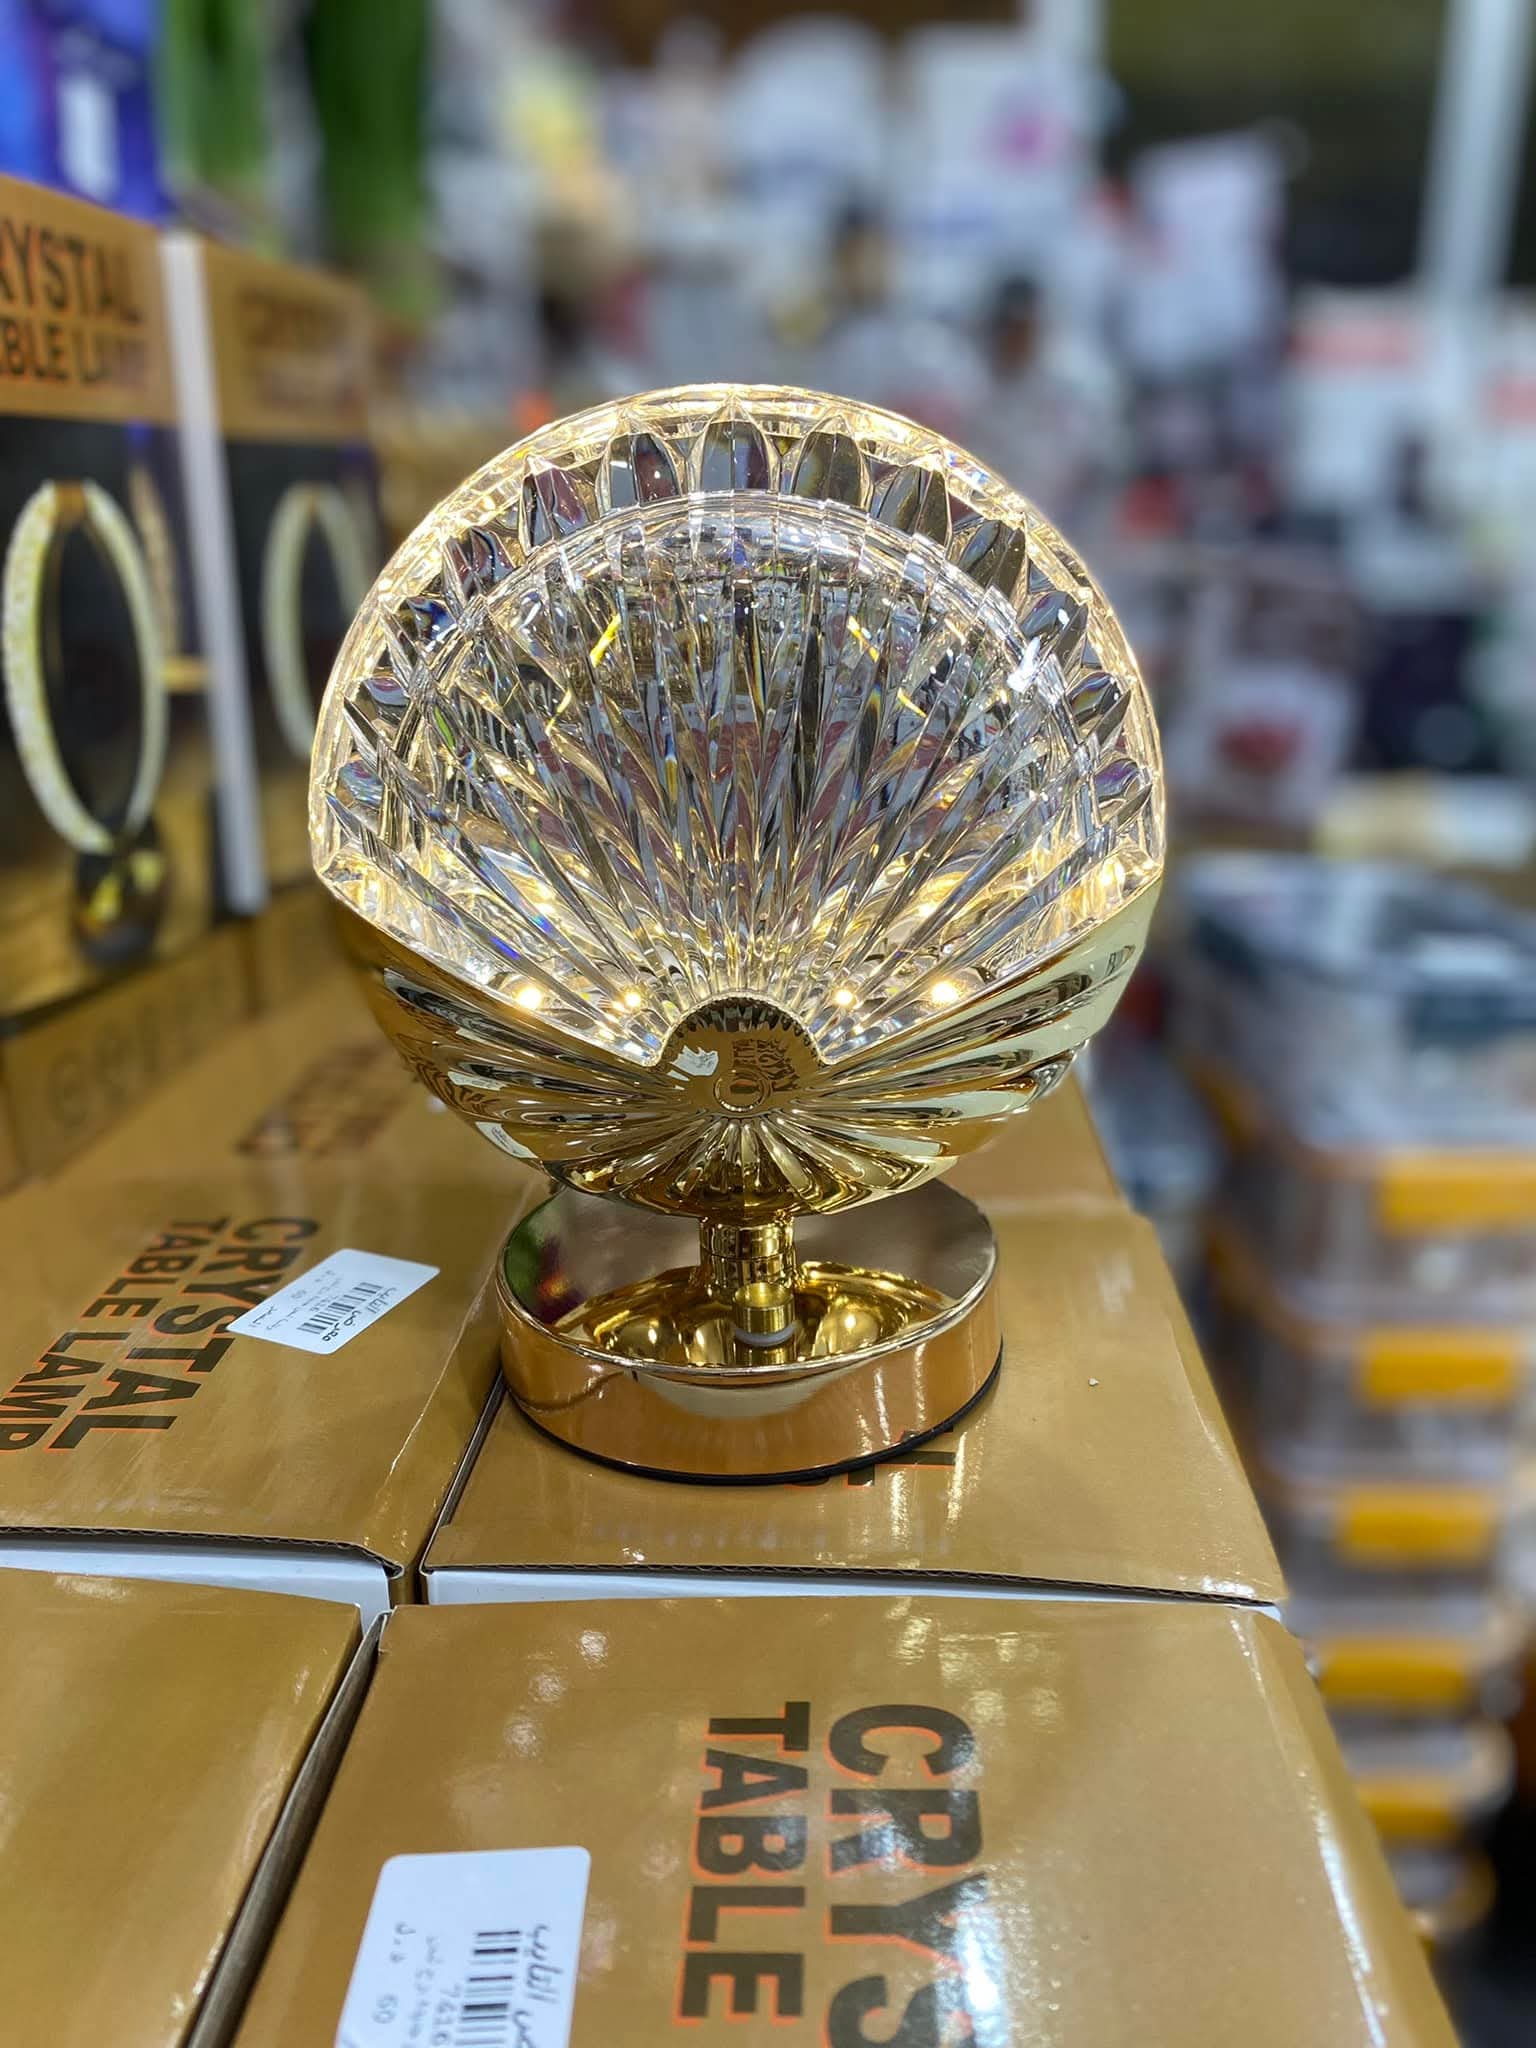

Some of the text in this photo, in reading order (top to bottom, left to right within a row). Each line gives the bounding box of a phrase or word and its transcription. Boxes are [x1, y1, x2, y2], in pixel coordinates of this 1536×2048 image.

[46, 1217, 319, 1452] CRYSTAL
[82, 1216, 231, 1319] TABLE
[322, 1310, 361, 1342] معرض
[0, 1331, 132, 1450] LAMP
[673, 1701, 811, 2024] TABLE
[824, 1703, 990, 2048] CRYS
